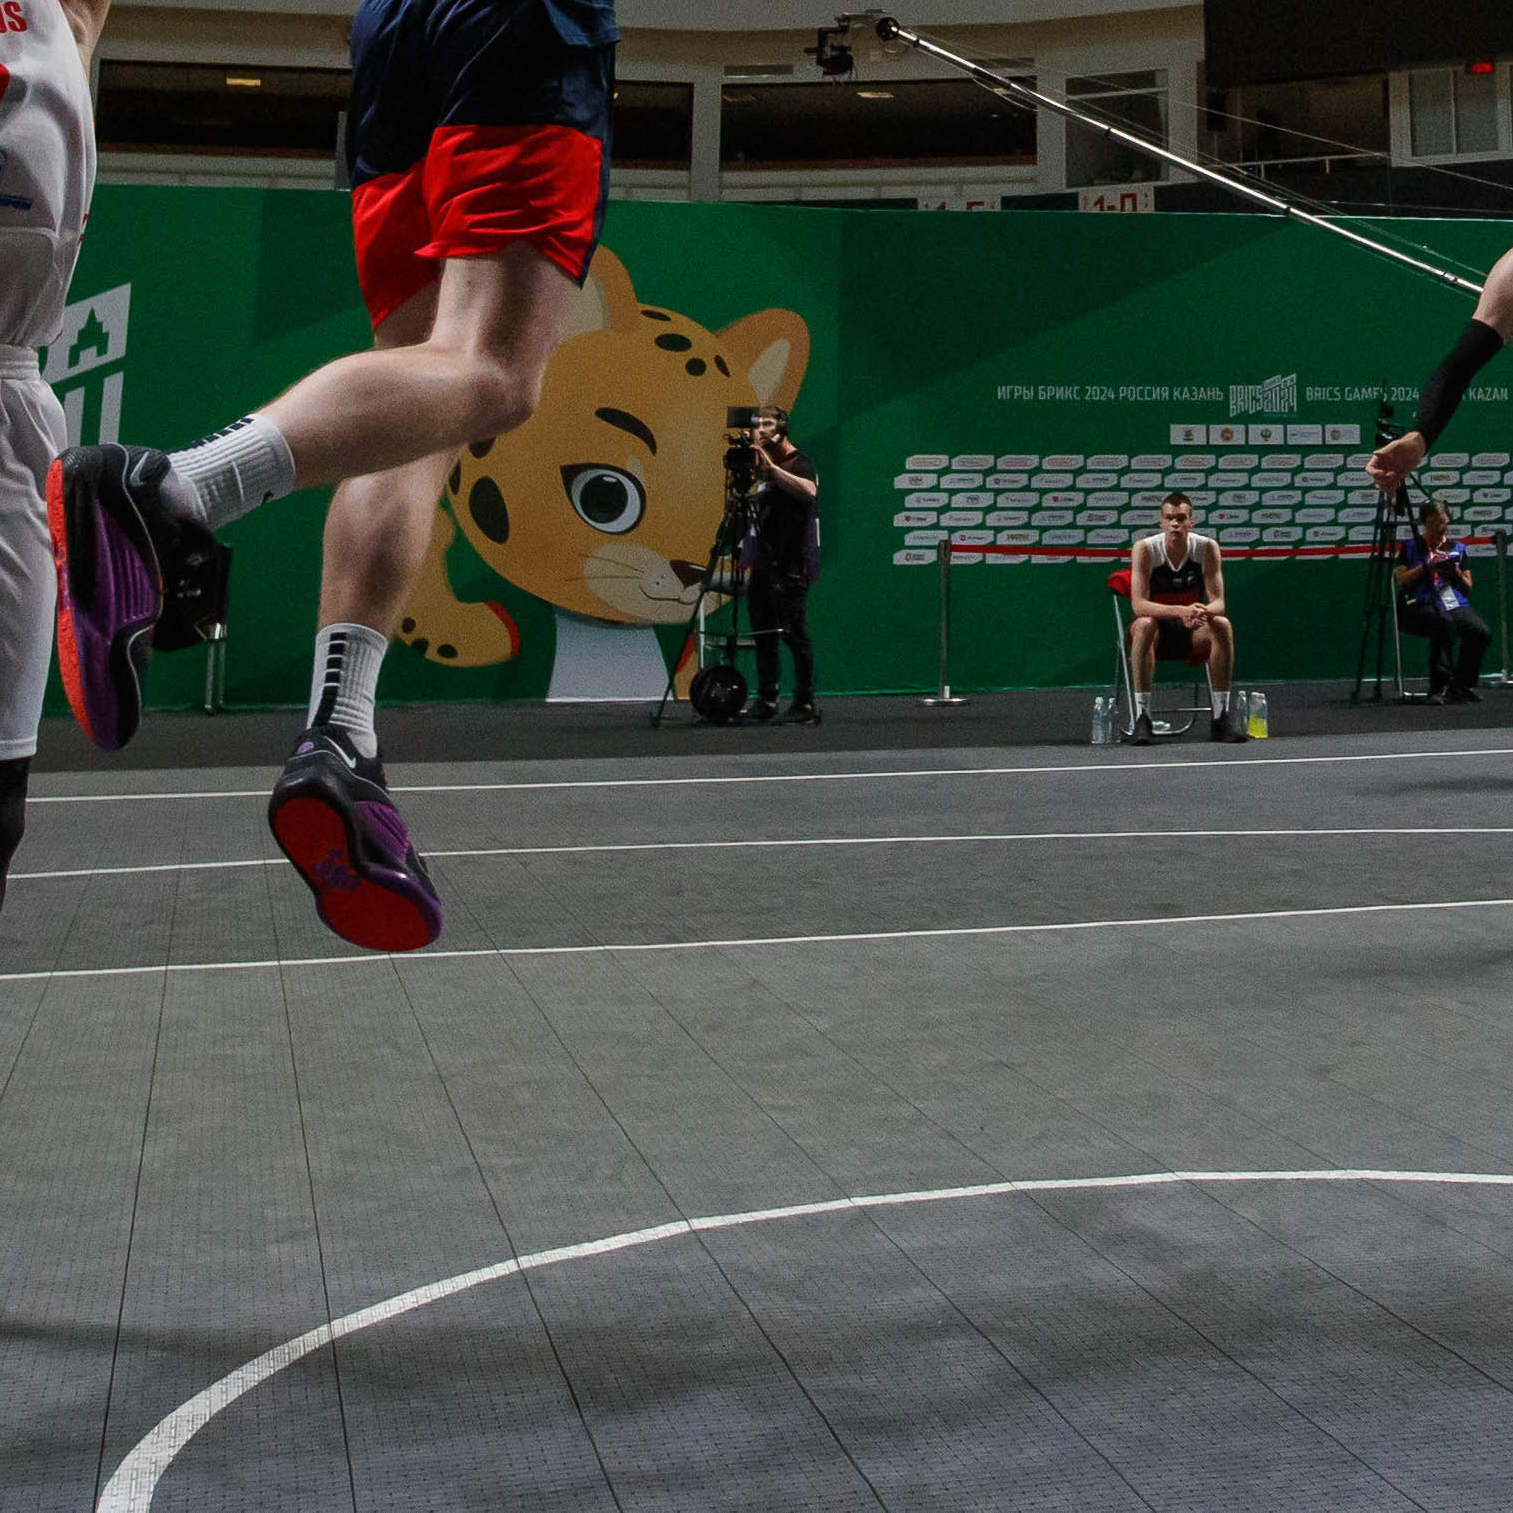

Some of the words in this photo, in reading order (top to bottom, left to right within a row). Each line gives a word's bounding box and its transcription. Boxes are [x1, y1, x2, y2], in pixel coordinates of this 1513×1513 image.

[997, 385, 1034, 401] ИГРЫ
[1038, 385, 1081, 401] БРИКС
[1084, 385, 1116, 401] 2024
[1118, 385, 1169, 401] РОССИЯ
[1172, 385, 1224, 401] КАЗАНЬ
[1305, 386, 1339, 402] BRICS
[1391, 386, 1420, 402] 2024
[1468, 386, 1509, 401] KAZAN
